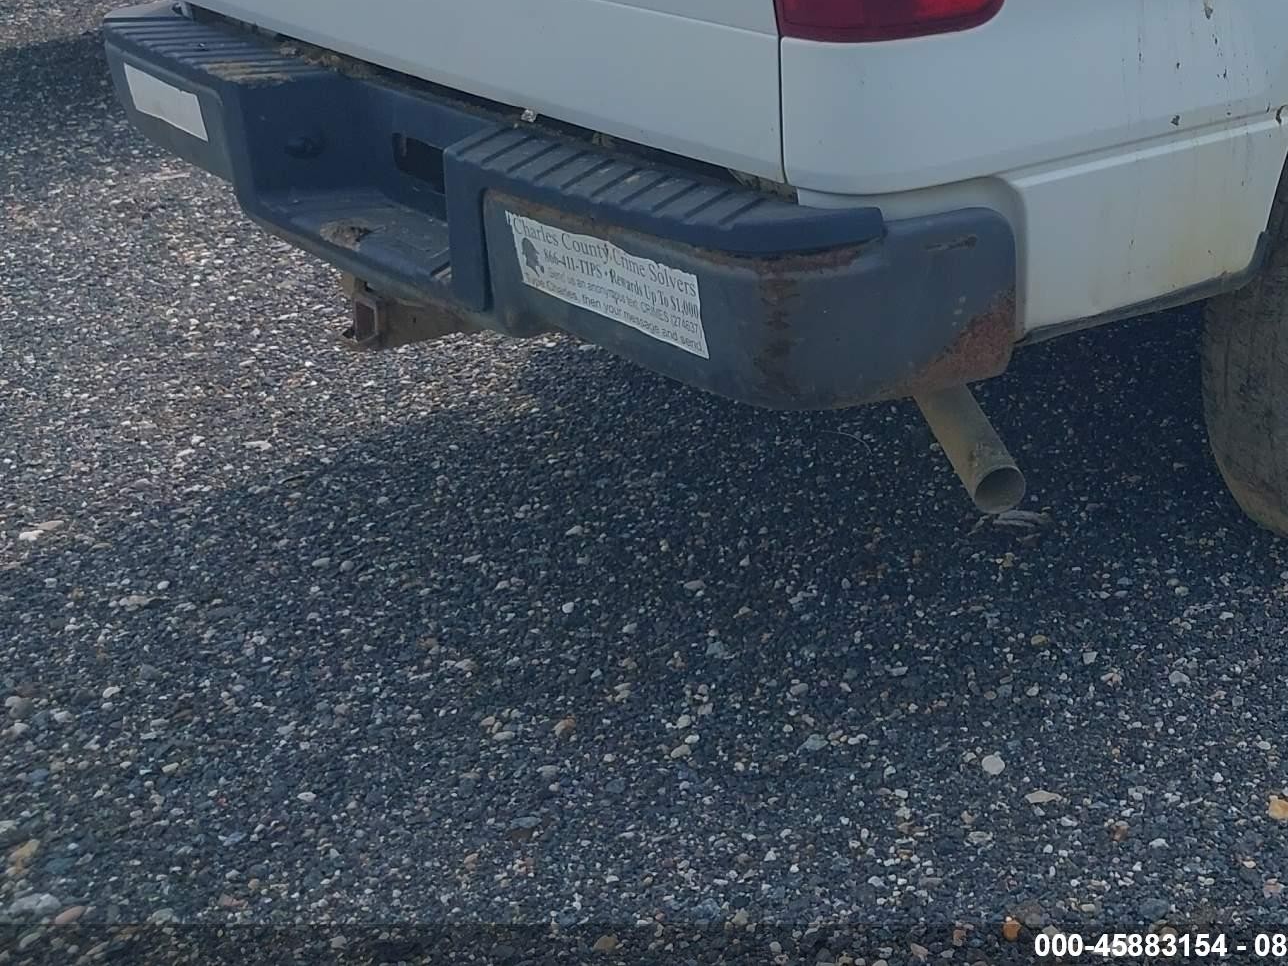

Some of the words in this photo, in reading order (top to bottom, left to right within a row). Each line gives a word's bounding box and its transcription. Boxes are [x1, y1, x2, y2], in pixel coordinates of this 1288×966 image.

[513, 217, 559, 247] Charles
[561, 232, 609, 265] County
[612, 247, 646, 278] Crime
[648, 263, 697, 298] Solvers
[610, 267, 643, 296] Rewards
[643, 282, 657, 306] Up
[657, 290, 670, 308] To
